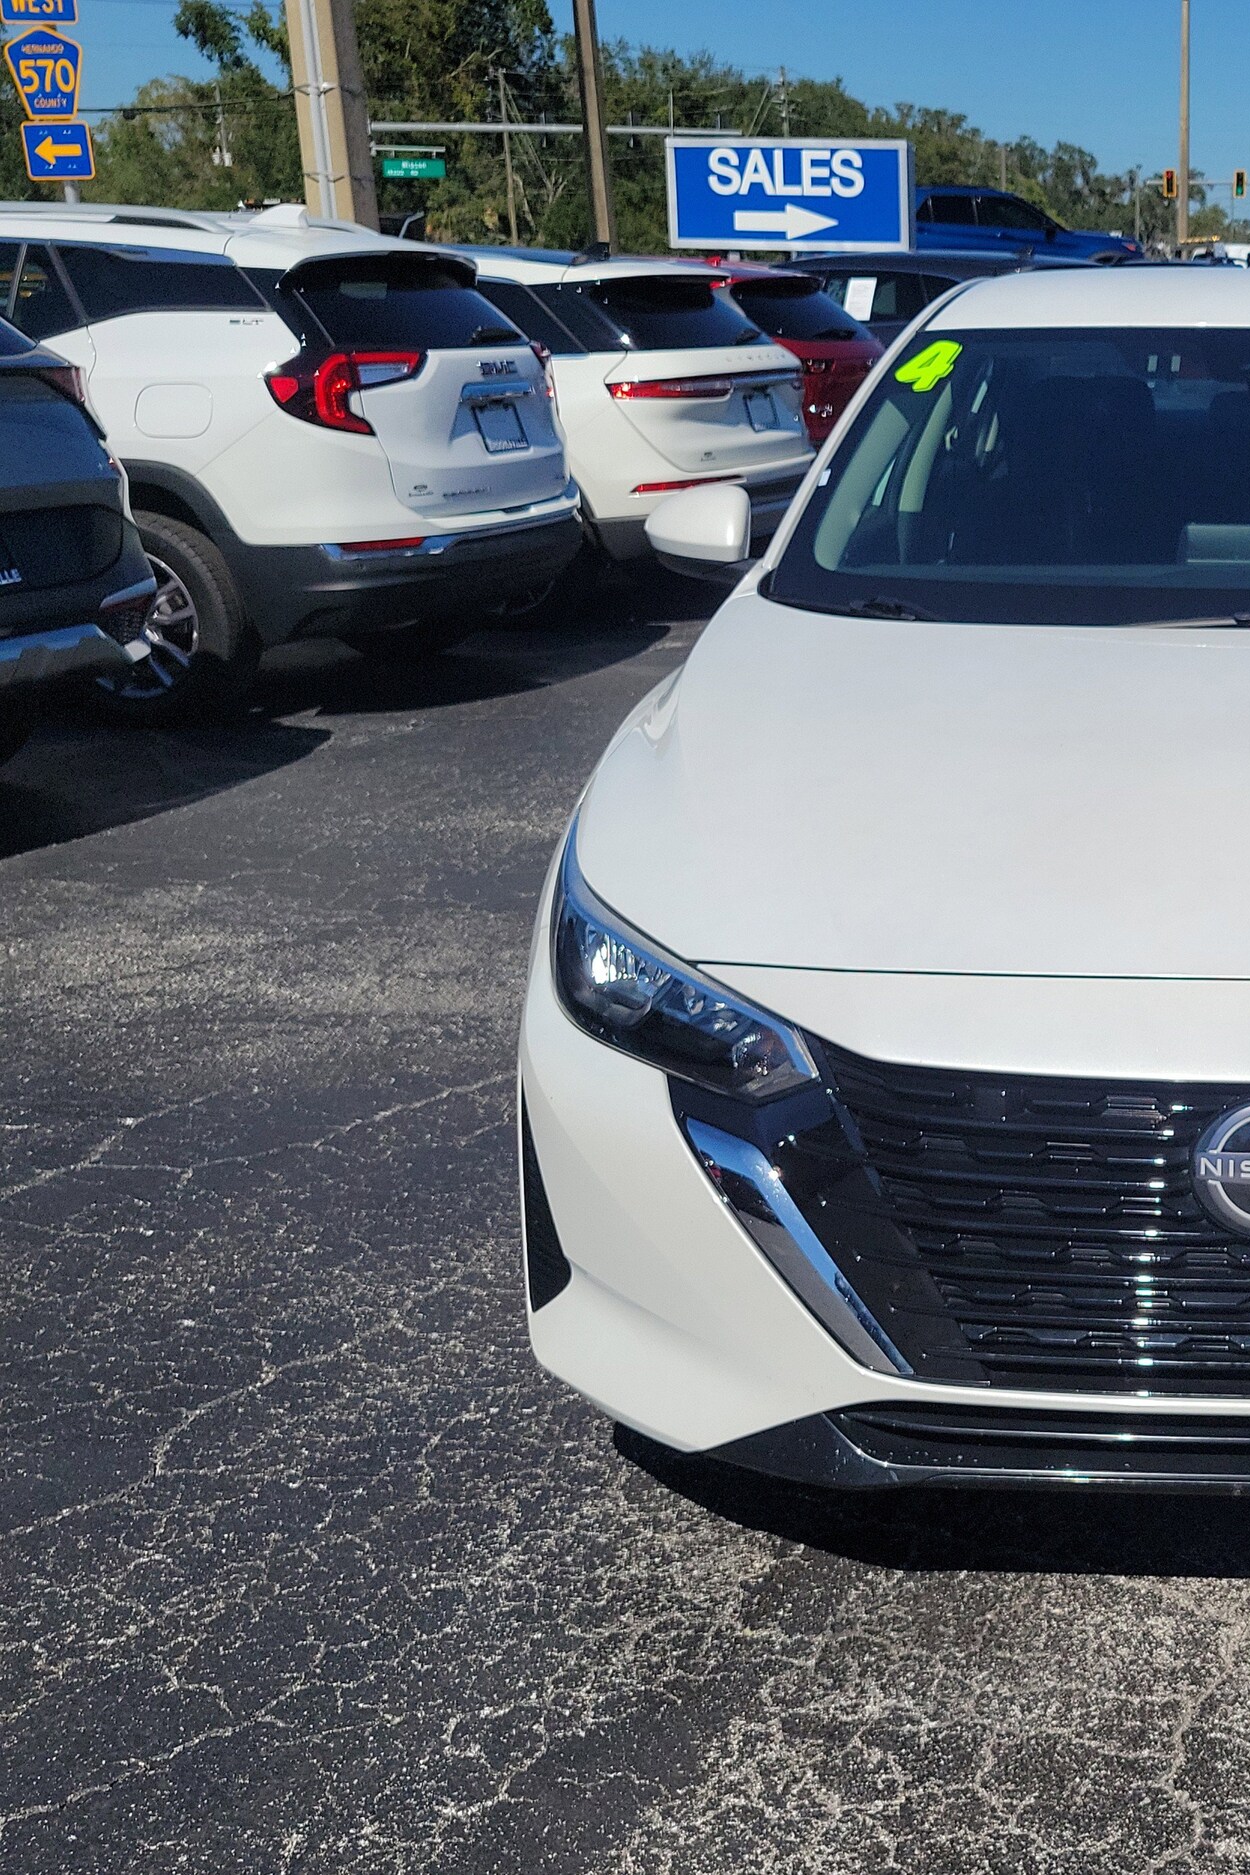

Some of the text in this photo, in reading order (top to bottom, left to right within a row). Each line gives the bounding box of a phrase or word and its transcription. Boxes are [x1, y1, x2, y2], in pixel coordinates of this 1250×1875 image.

[19, 59, 75, 93] 570
[34, 97, 67, 108] COUNTY
[707, 147, 865, 198] SALES
[894, 340, 963, 392] 4
